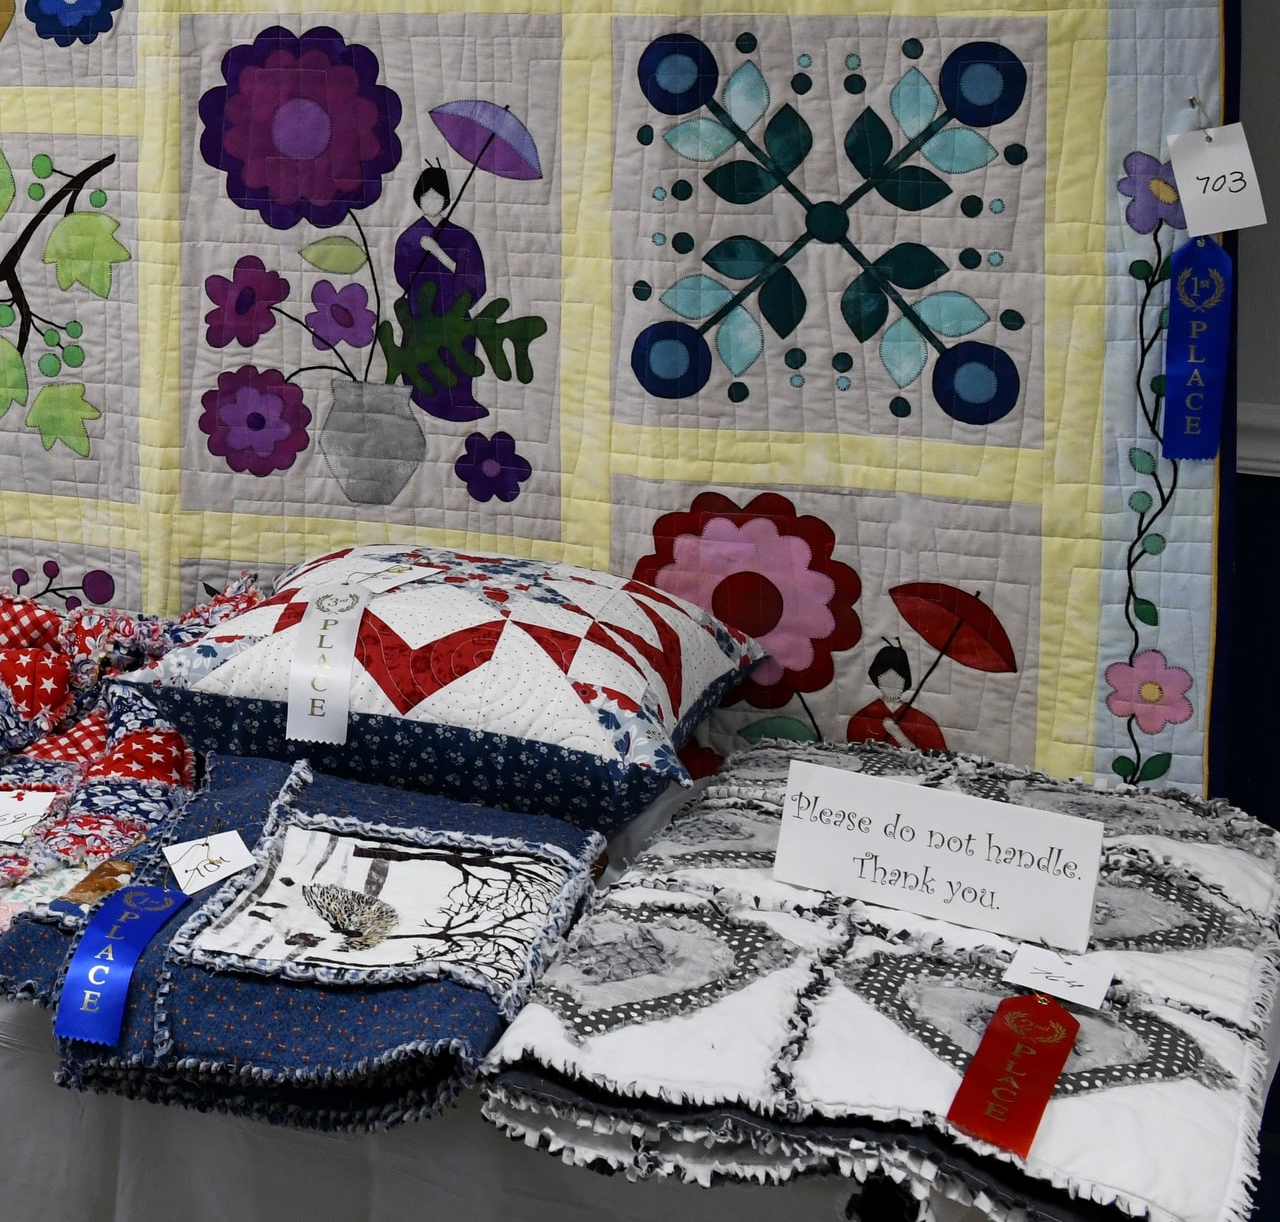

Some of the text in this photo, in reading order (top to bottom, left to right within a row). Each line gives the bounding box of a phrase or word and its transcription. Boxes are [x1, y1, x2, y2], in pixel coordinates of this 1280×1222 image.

[1196, 171, 1247, 194] 703
[1191, 277, 1210, 297] 1st
[1184, 320, 1208, 435] PLACE
[327, 597, 349, 607] 3rd
[308, 619, 339, 717] PLACE
[791, 791, 1082, 881] Please do not handle.
[852, 851, 1000, 911] Thank you.
[79, 911, 140, 1014] PLACE
[1030, 966, 1085, 988] 764
[983, 1041, 1037, 1123] PLACE
